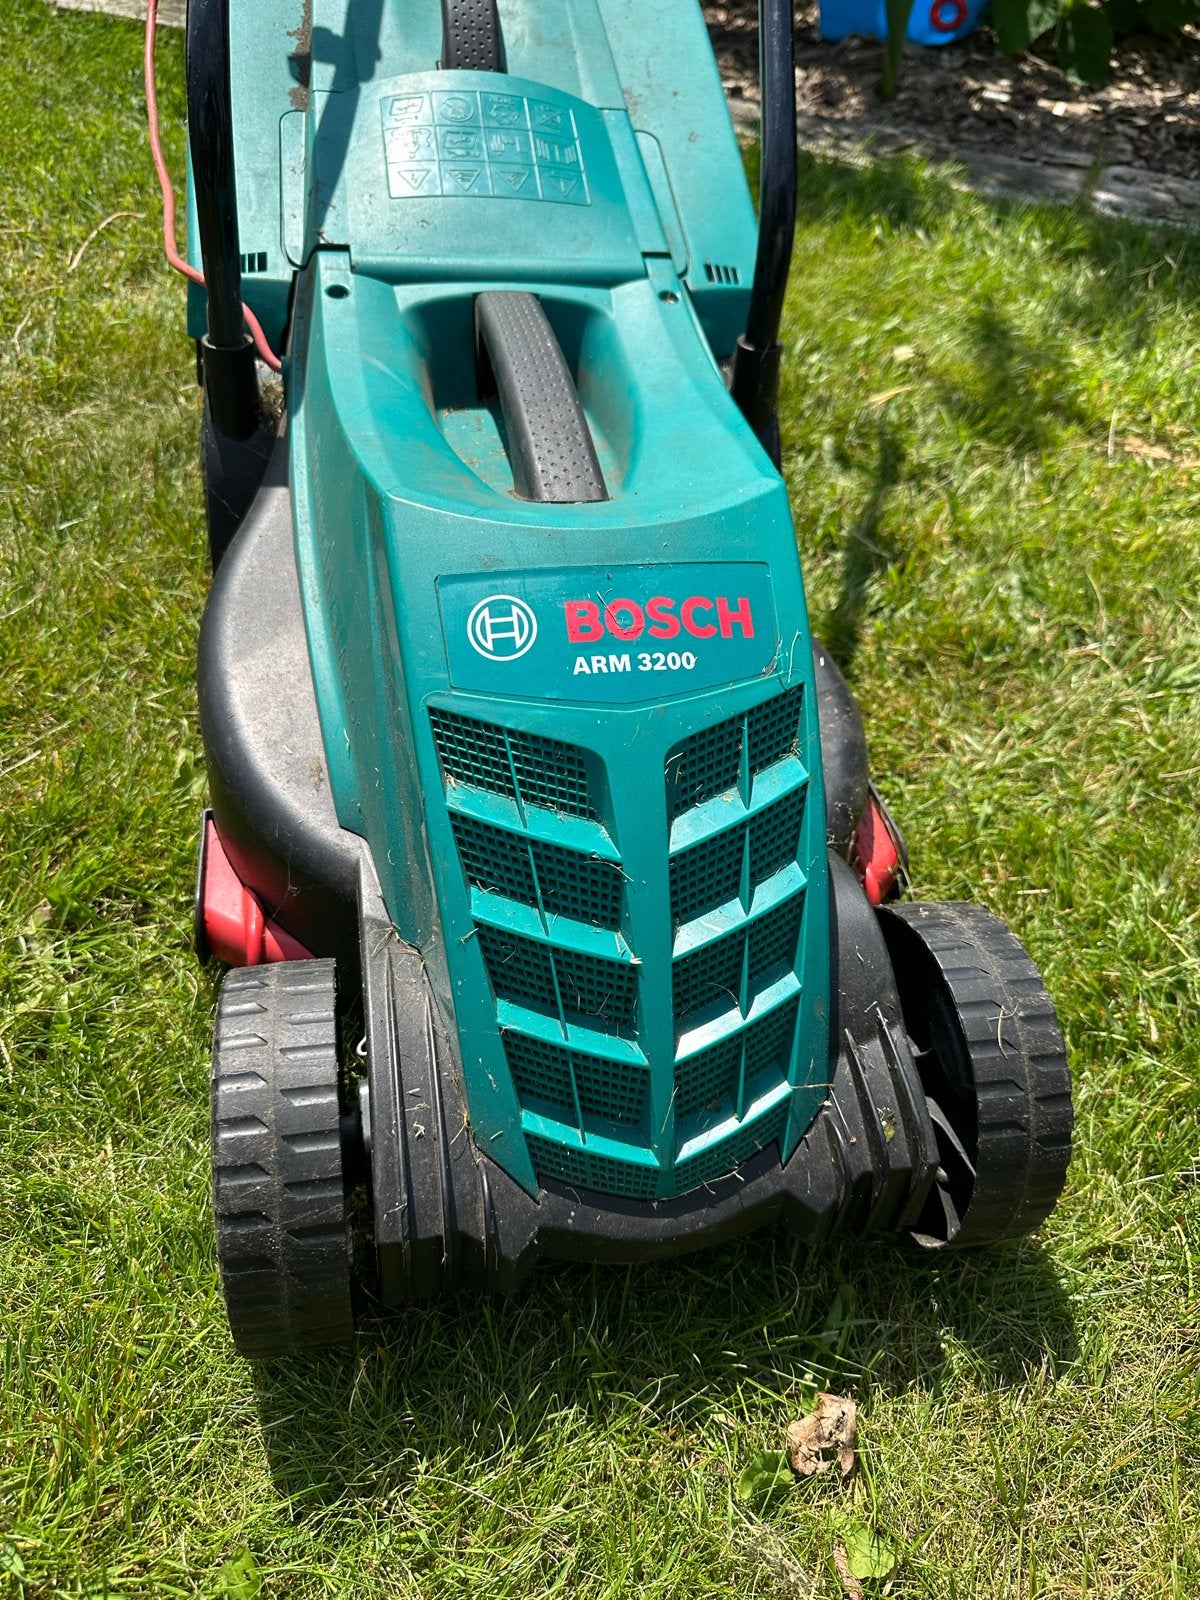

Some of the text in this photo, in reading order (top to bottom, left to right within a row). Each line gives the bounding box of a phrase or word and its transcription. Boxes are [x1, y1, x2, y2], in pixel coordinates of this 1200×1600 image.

[565, 596, 755, 643] BOSCH
[573, 651, 697, 675] ARM 3200
